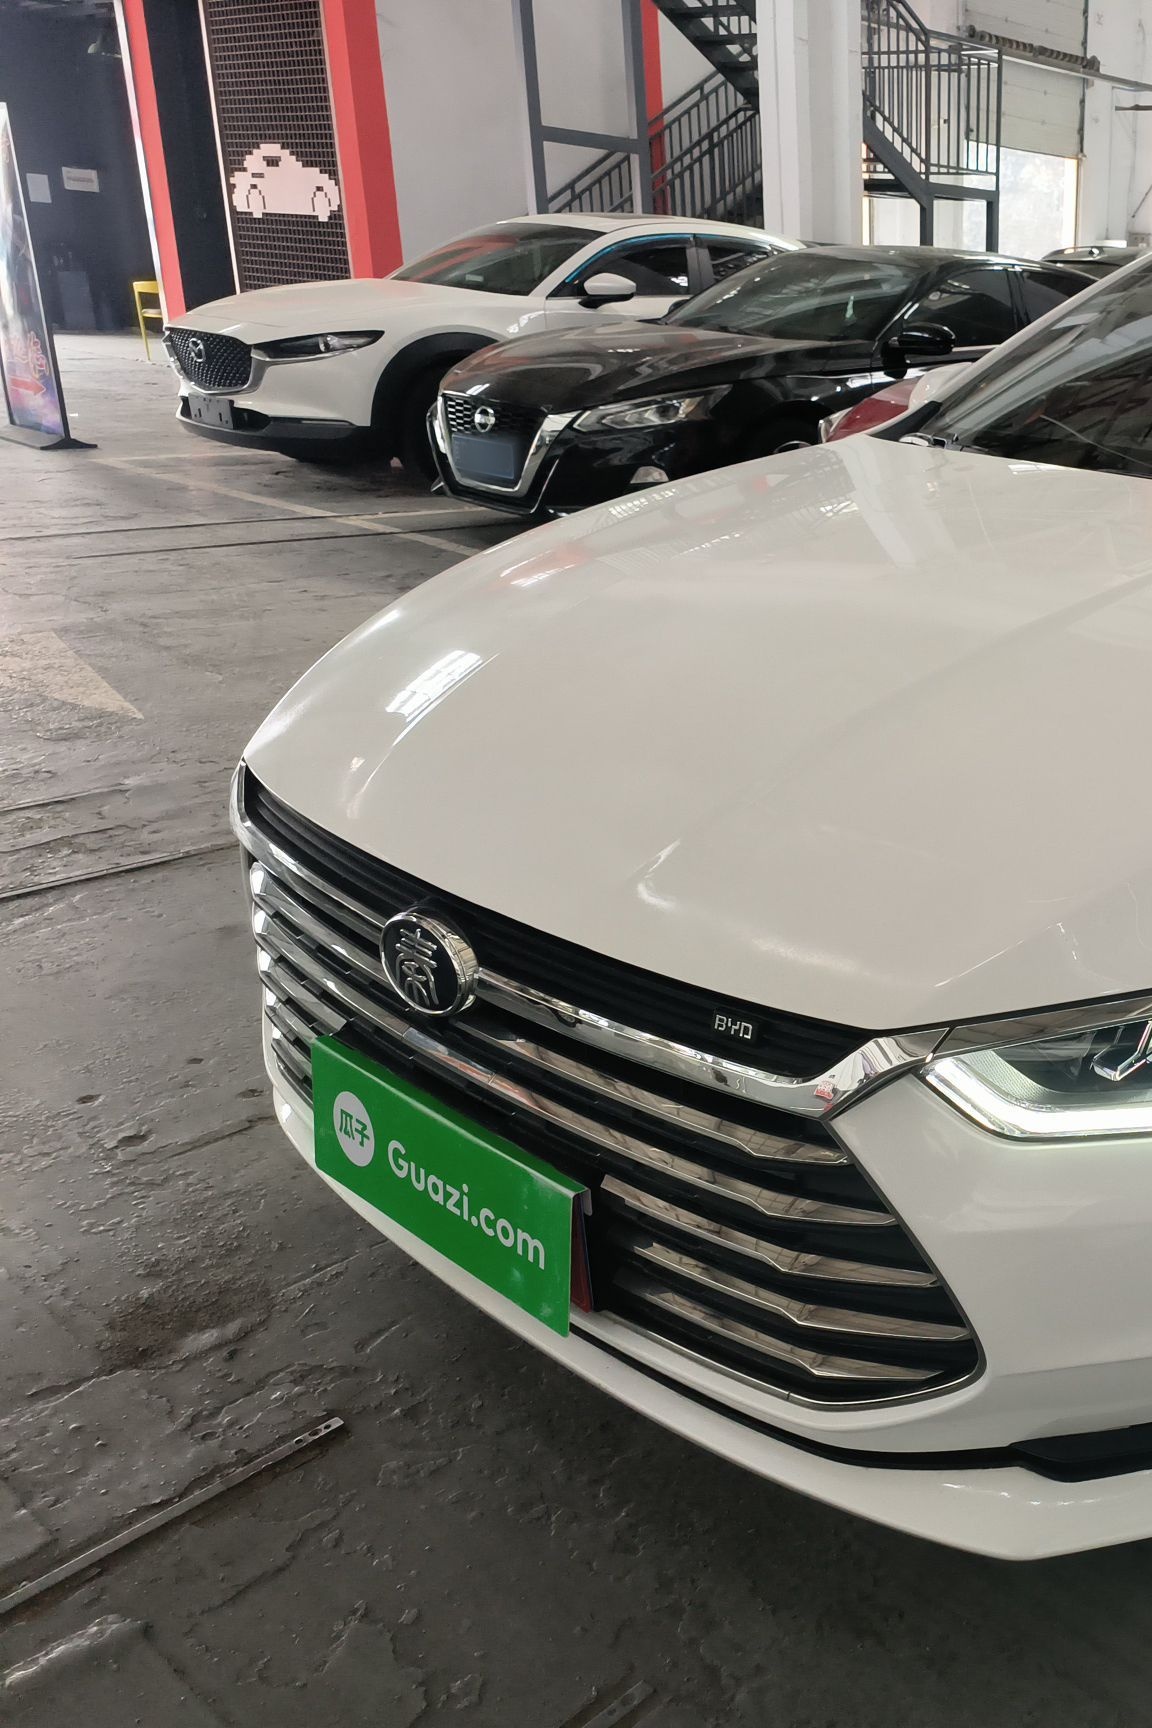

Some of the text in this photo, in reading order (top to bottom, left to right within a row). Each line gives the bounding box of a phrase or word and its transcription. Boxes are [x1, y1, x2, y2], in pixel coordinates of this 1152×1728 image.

[714, 1014, 753, 1039] BYD
[340, 1108, 370, 1148] 瓜子
[387, 1139, 545, 1271] Guazi.com
